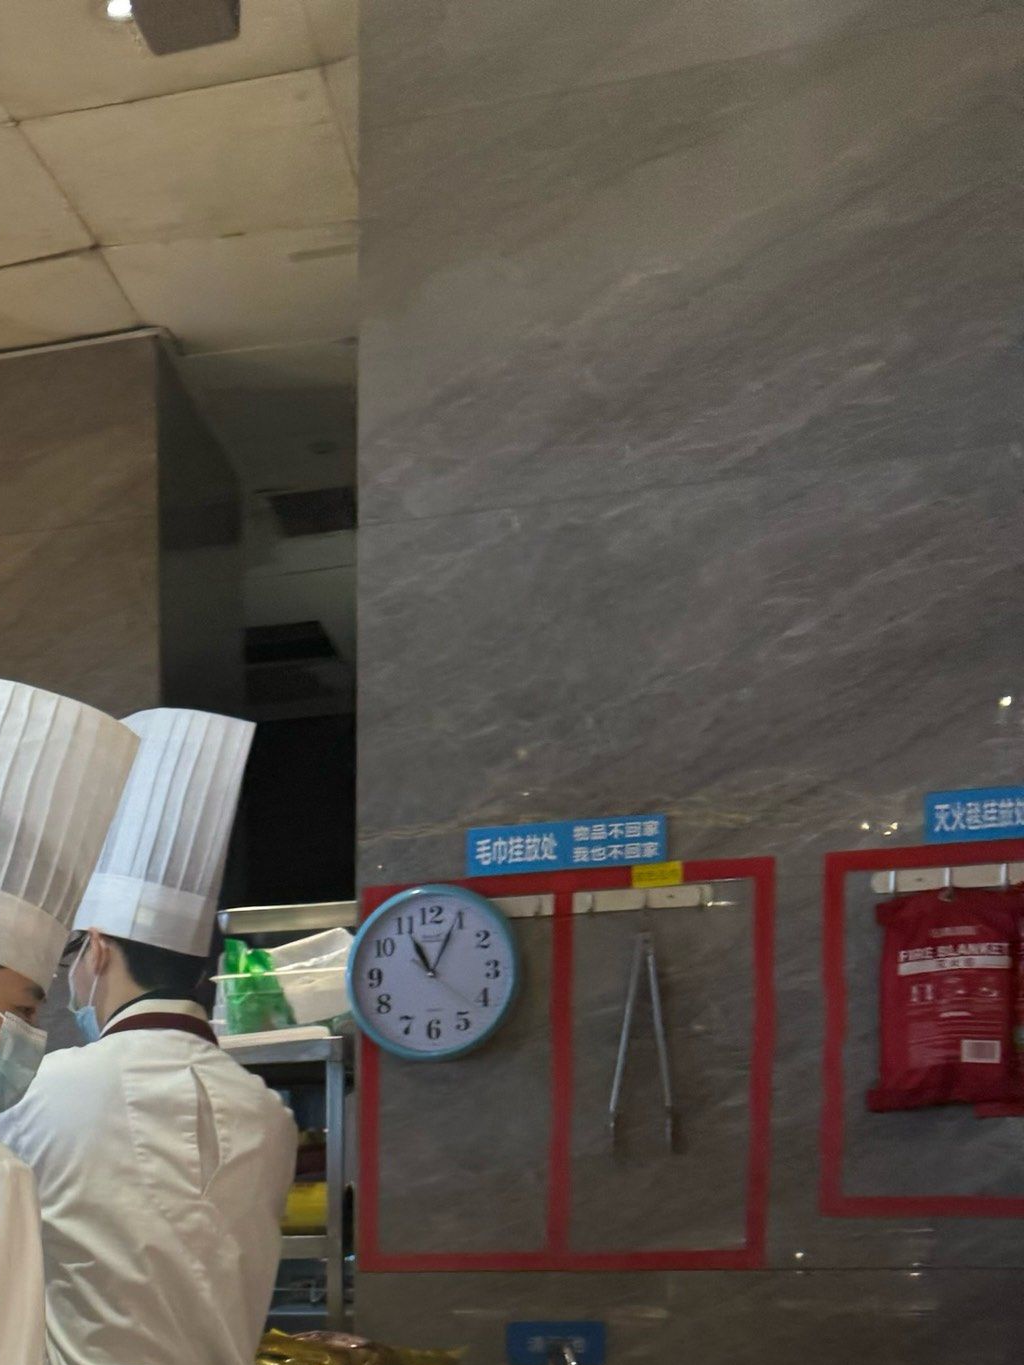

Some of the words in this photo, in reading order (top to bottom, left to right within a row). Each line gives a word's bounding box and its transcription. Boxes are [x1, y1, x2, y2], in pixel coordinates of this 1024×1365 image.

[475, 833, 558, 866] 毛巾挂放处
[420, 905, 444, 925] 12
[396, 916, 413, 935] 11
[376, 937, 395, 958] 10
[475, 930, 491, 949] 2
[368, 968, 383, 988] 9
[485, 959, 501, 979] 3
[377, 993, 391, 1014] 8
[474, 987, 490, 1007] 4
[400, 1015, 415, 1035] 7
[427, 1019, 441, 1040] 6
[456, 1011, 471, 1031] 5
